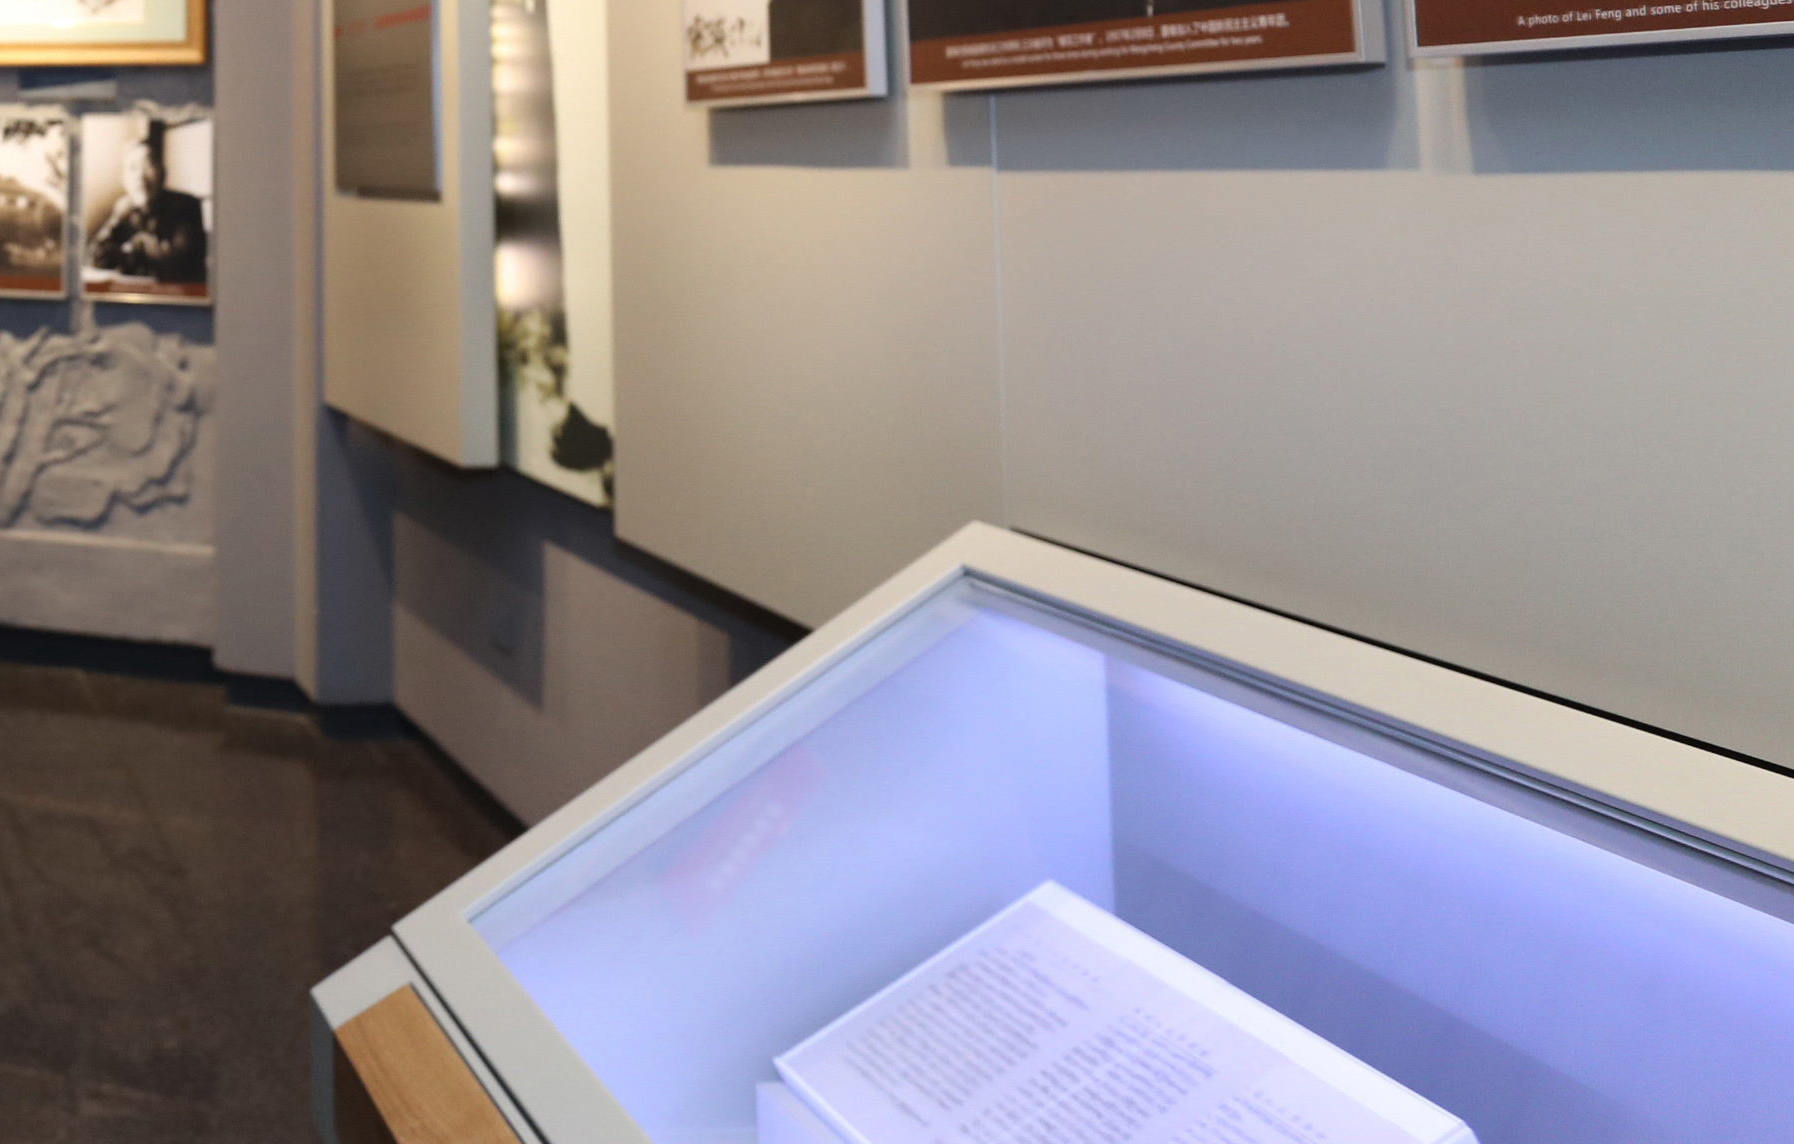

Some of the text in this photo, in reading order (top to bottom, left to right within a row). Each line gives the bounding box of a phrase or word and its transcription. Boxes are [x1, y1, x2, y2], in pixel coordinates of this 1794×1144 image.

[1518, 16, 1525, 26] A
[1528, 14, 1559, 27] photo
[1562, 11, 1574, 22] of
[1576, 10, 1592, 21] Lei
[1595, 8, 1622, 21] Feng
[1626, 5, 1646, 16] and
[1650, 5, 1682, 15] some
[1686, 0, 1698, 12] of
[1702, 0, 1720, 10] his
